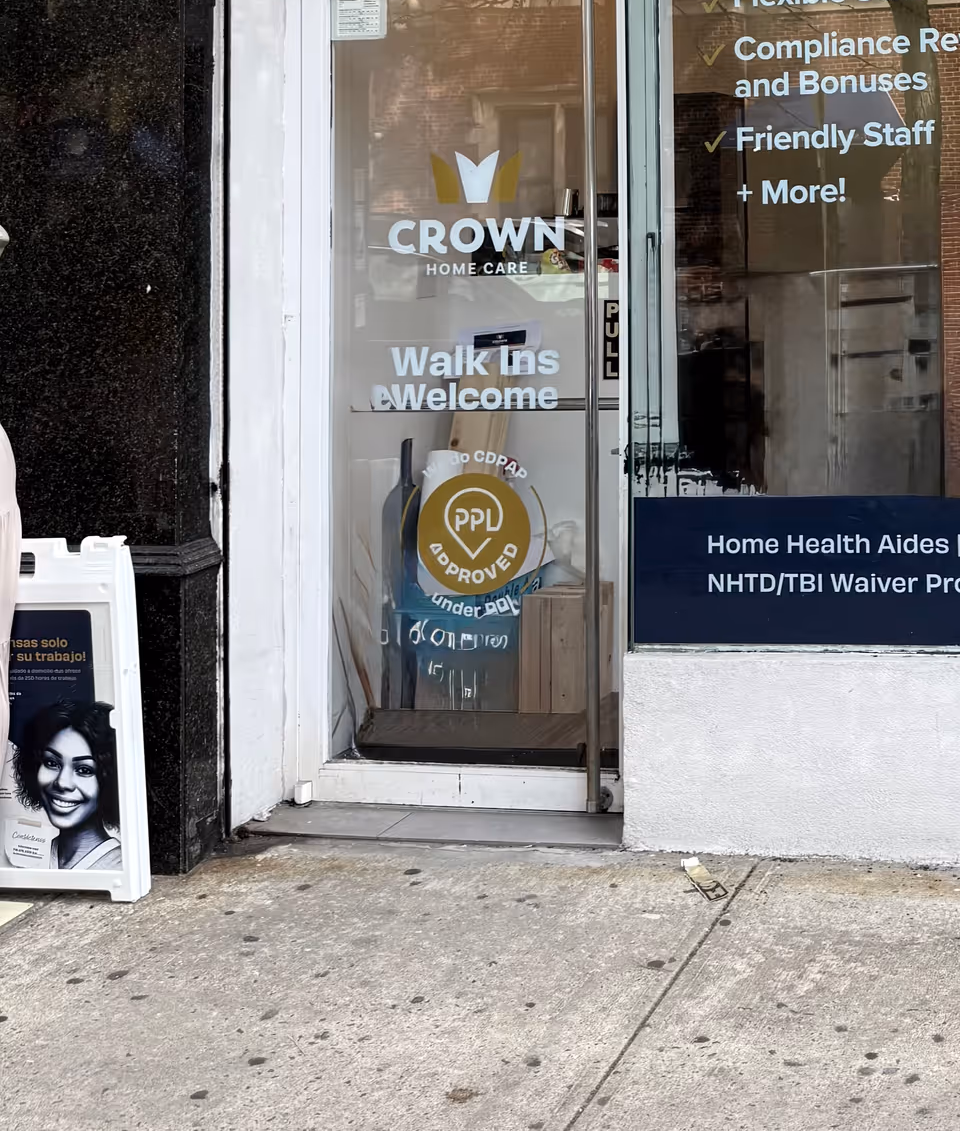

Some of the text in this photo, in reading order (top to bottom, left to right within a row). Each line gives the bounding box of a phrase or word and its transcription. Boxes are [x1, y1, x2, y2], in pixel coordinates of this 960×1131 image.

[734, 29, 910, 66] Compliance
[735, 69, 928, 99] and Bonuses
[735, 119, 937, 156] Friendly Staff
[762, 178, 847, 206] More!
[388, 216, 565, 254] CROWN
[426, 262, 528, 276] HOME CARE
[606, 302, 619, 377] PULL
[391, 345, 560, 376] Walk Ins
[392, 383, 559, 410] Welcome
[474, 450, 528, 479] CDPAP
[455, 508, 499, 532] PPL
[707, 534, 779, 555] Home
[787, 534, 870, 555] Health
[878, 534, 950, 555] Aides
[707, 573, 824, 596] NHTD/TBI
[831, 573, 918, 594] Waiver
[10, 637, 68, 648] nsas solo
[17, 653, 32, 661] su
[35, 651, 86, 663] trabajo!
